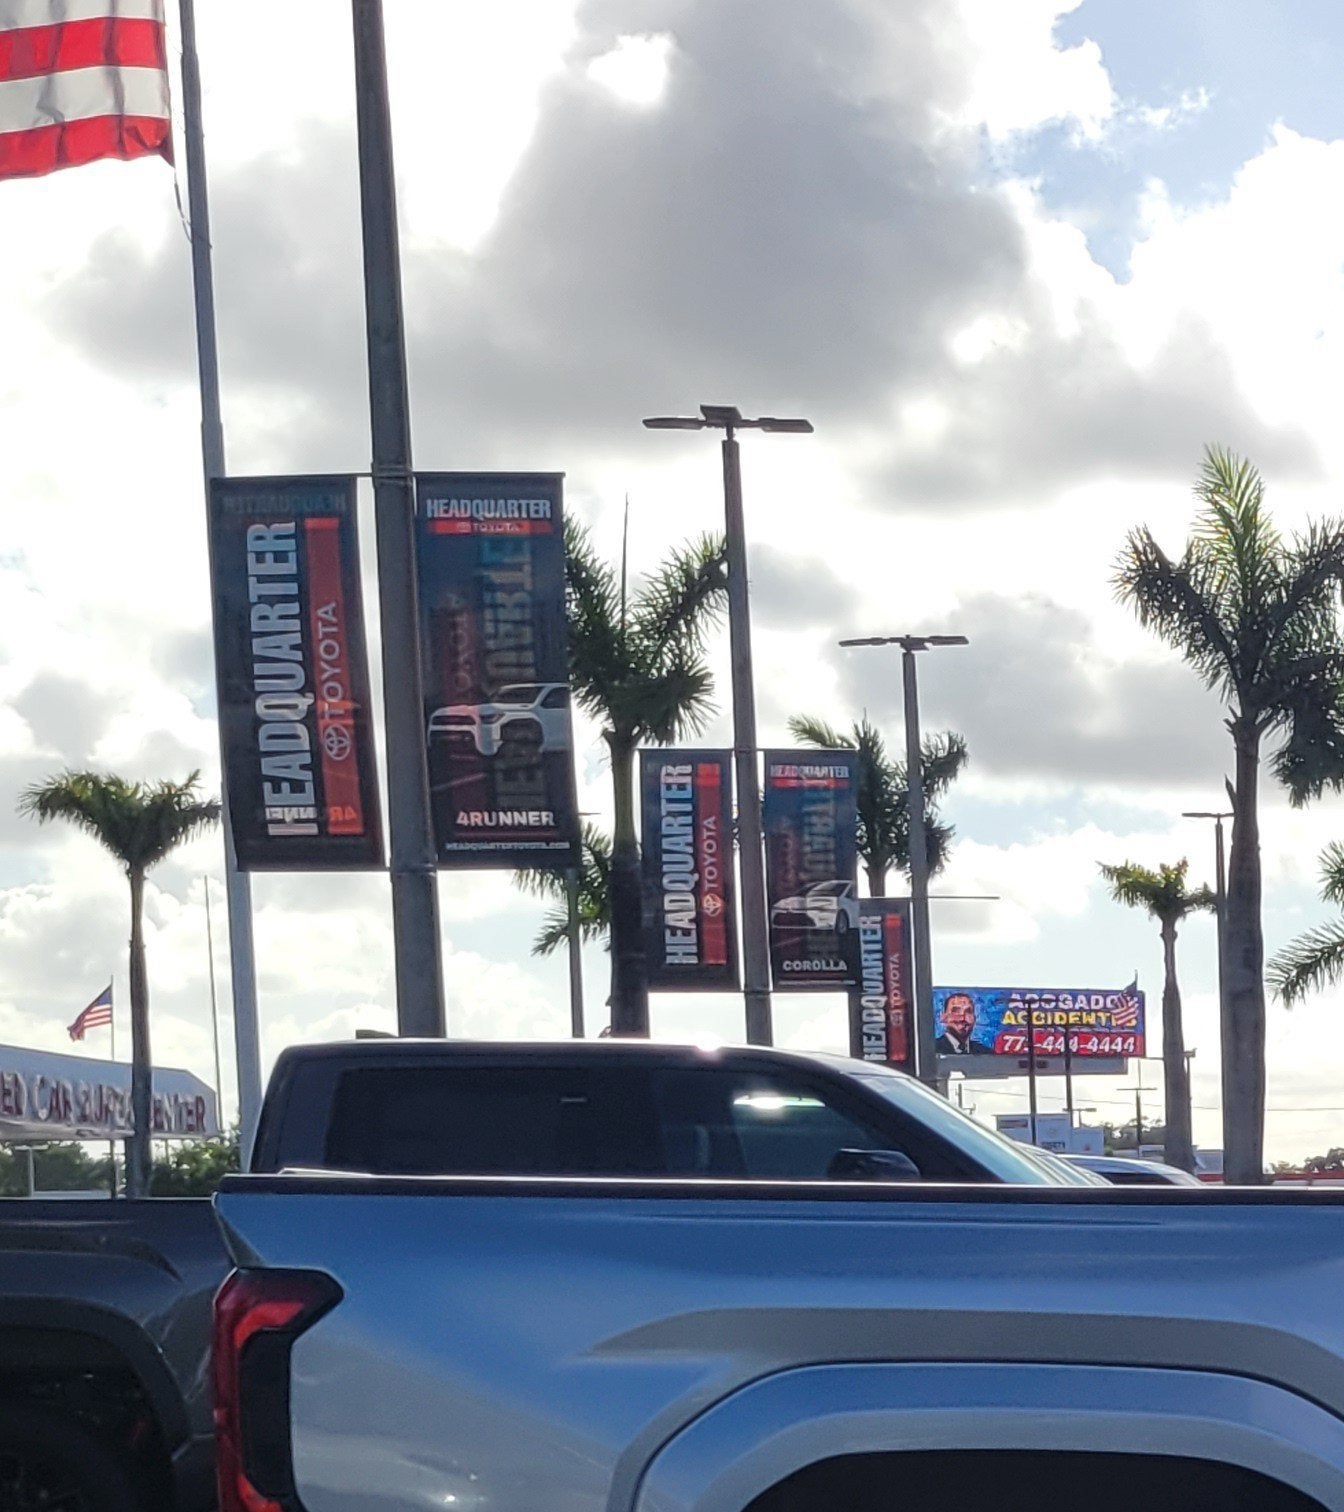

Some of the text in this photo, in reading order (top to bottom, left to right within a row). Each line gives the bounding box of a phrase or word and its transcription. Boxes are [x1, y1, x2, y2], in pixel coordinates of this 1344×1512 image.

[427, 499, 551, 519] HEADQUARTER
[472, 522, 520, 532] TOYOTA
[246, 521, 320, 836] HEADQUARTER
[317, 601, 347, 721] TOYOTA
[770, 765, 849, 779] HEADQUARTER
[456, 811, 555, 826] 4RUNNER
[660, 764, 699, 966] HEADQUARTER
[703, 815, 718, 892] TOYOTA
[782, 960, 848, 972] COROLLA
[889, 953, 904, 1010] TOYOTA
[860, 914, 888, 1061] HEADQUARTER
[1003, 1034, 1135, 1052] 77-444-4444
